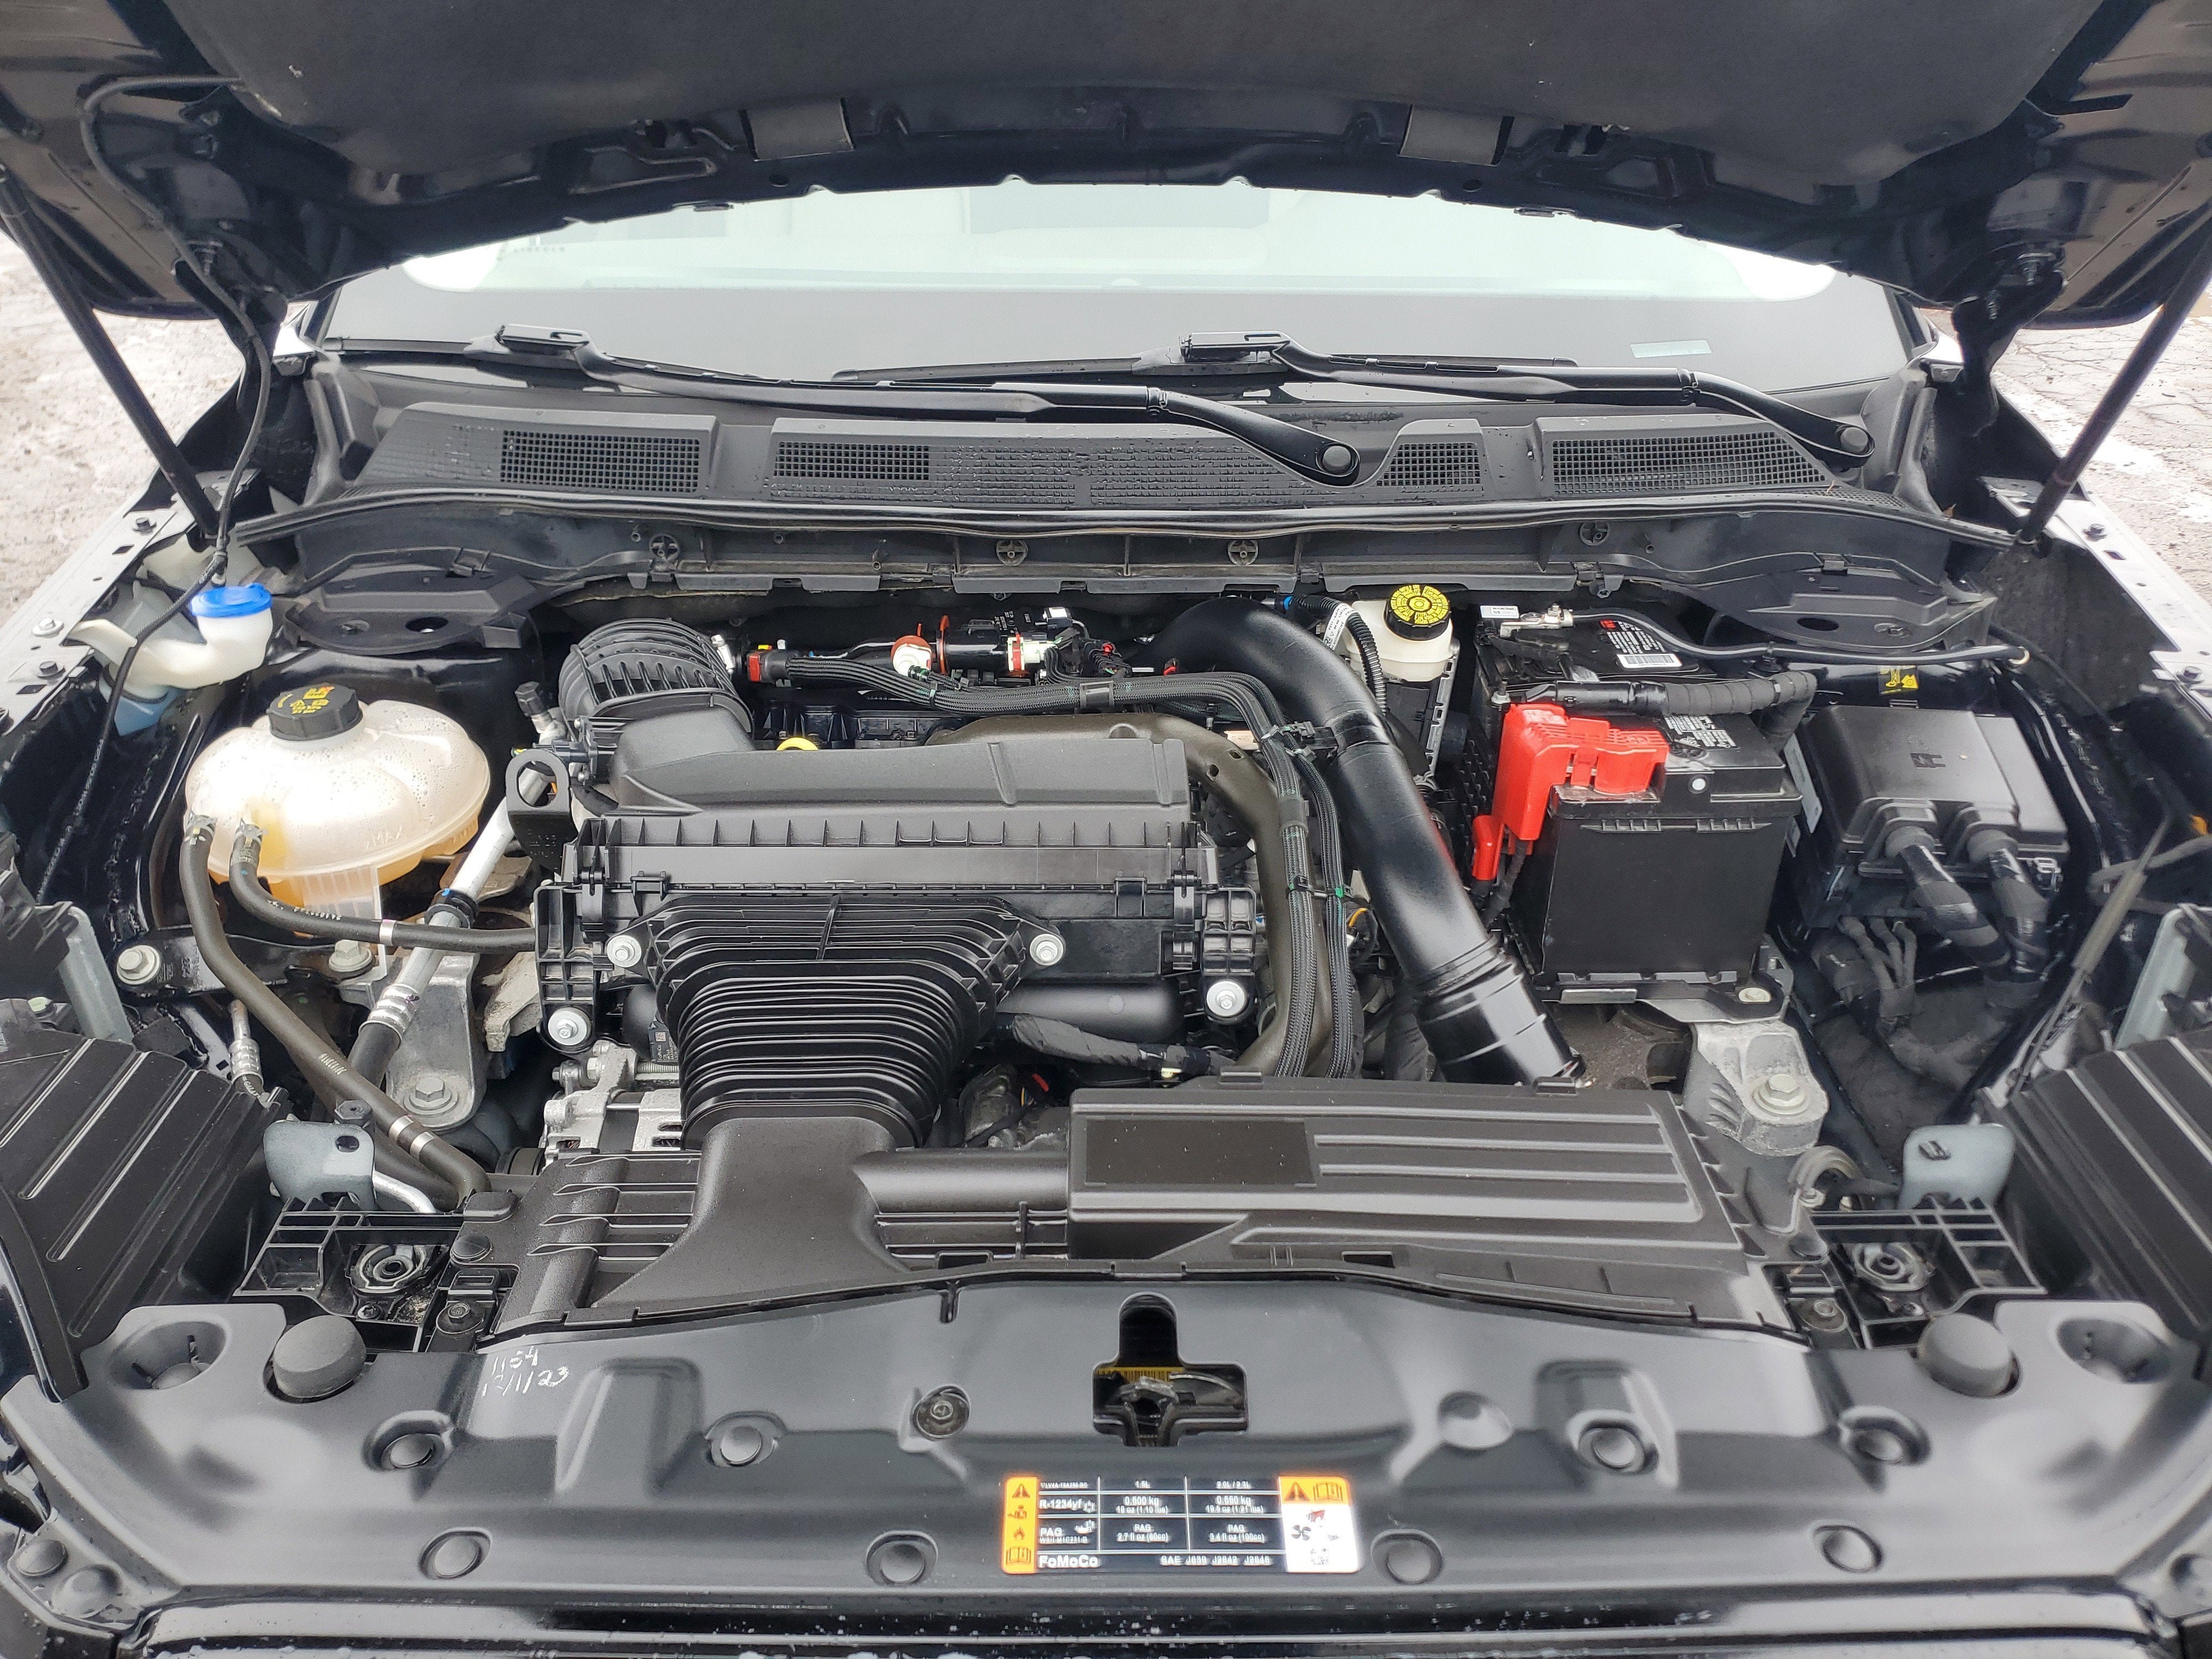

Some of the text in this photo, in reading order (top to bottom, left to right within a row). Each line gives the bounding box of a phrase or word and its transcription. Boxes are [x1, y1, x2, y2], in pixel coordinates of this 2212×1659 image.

[1039, 1498, 1082, 1510] R-1234yf
[1148, 1496, 1160, 1507] kg
[1240, 1495, 1251, 1507] kg
[1040, 1527, 1063, 1537] PAG
[1133, 1523, 1152, 1532] PAG
[1227, 1524, 1245, 1532] PAG
[1039, 1554, 1099, 1568] FoMoCo
[1160, 1555, 1181, 1566] SAE
